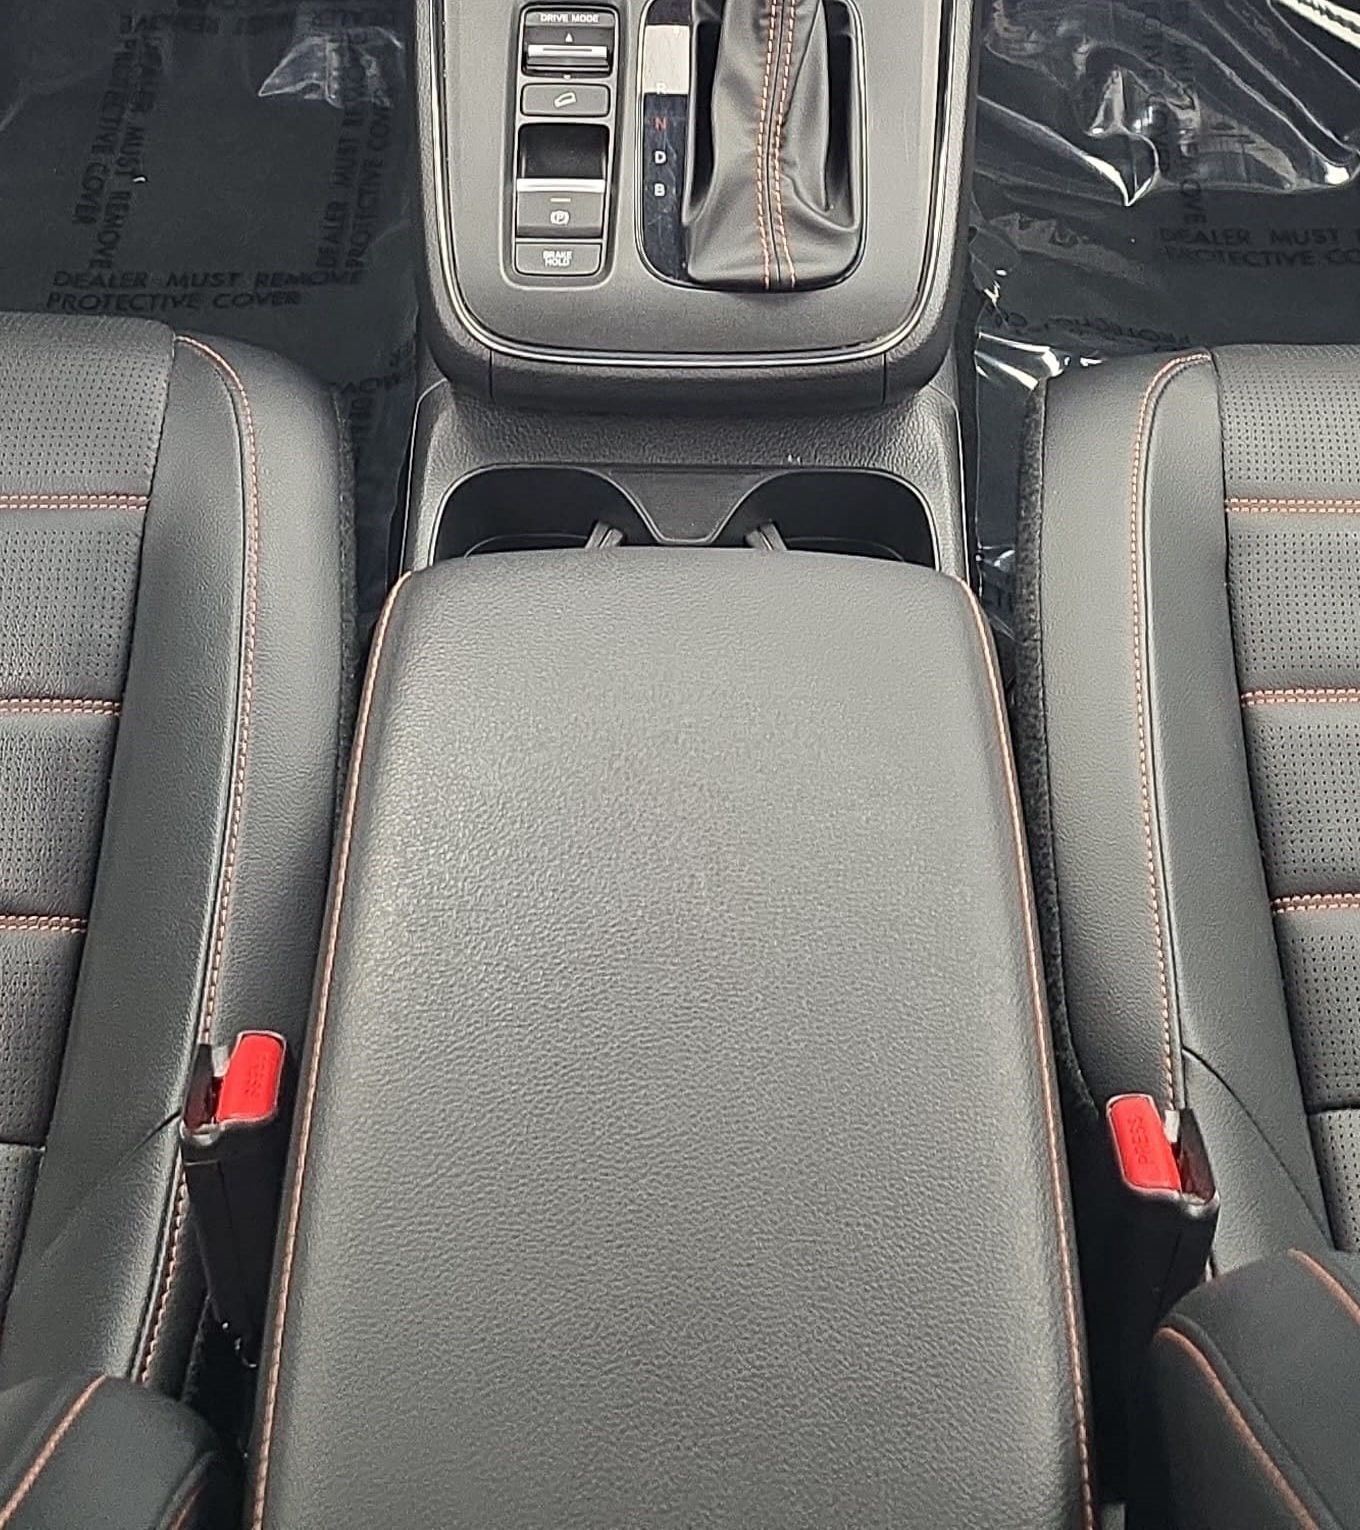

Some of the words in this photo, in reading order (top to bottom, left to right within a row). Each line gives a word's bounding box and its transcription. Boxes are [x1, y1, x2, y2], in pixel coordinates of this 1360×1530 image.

[540, 13, 569, 23] DRIVE
[571, 13, 600, 23] MODE
[655, 117, 667, 131] N
[654, 150, 667, 164] D
[654, 183, 666, 197] B
[1159, 226, 1252, 246] DEALER
[1269, 225, 1340, 246] MUST
[543, 250, 573, 260] BRAKE
[545, 257, 570, 267] HOLD
[52, 270, 148, 289] DEALER
[166, 270, 238, 288] MUST
[254, 268, 365, 288] REMOVE
[46, 292, 200, 311] PROTECTIVE
[212, 290, 302, 309] COVER
